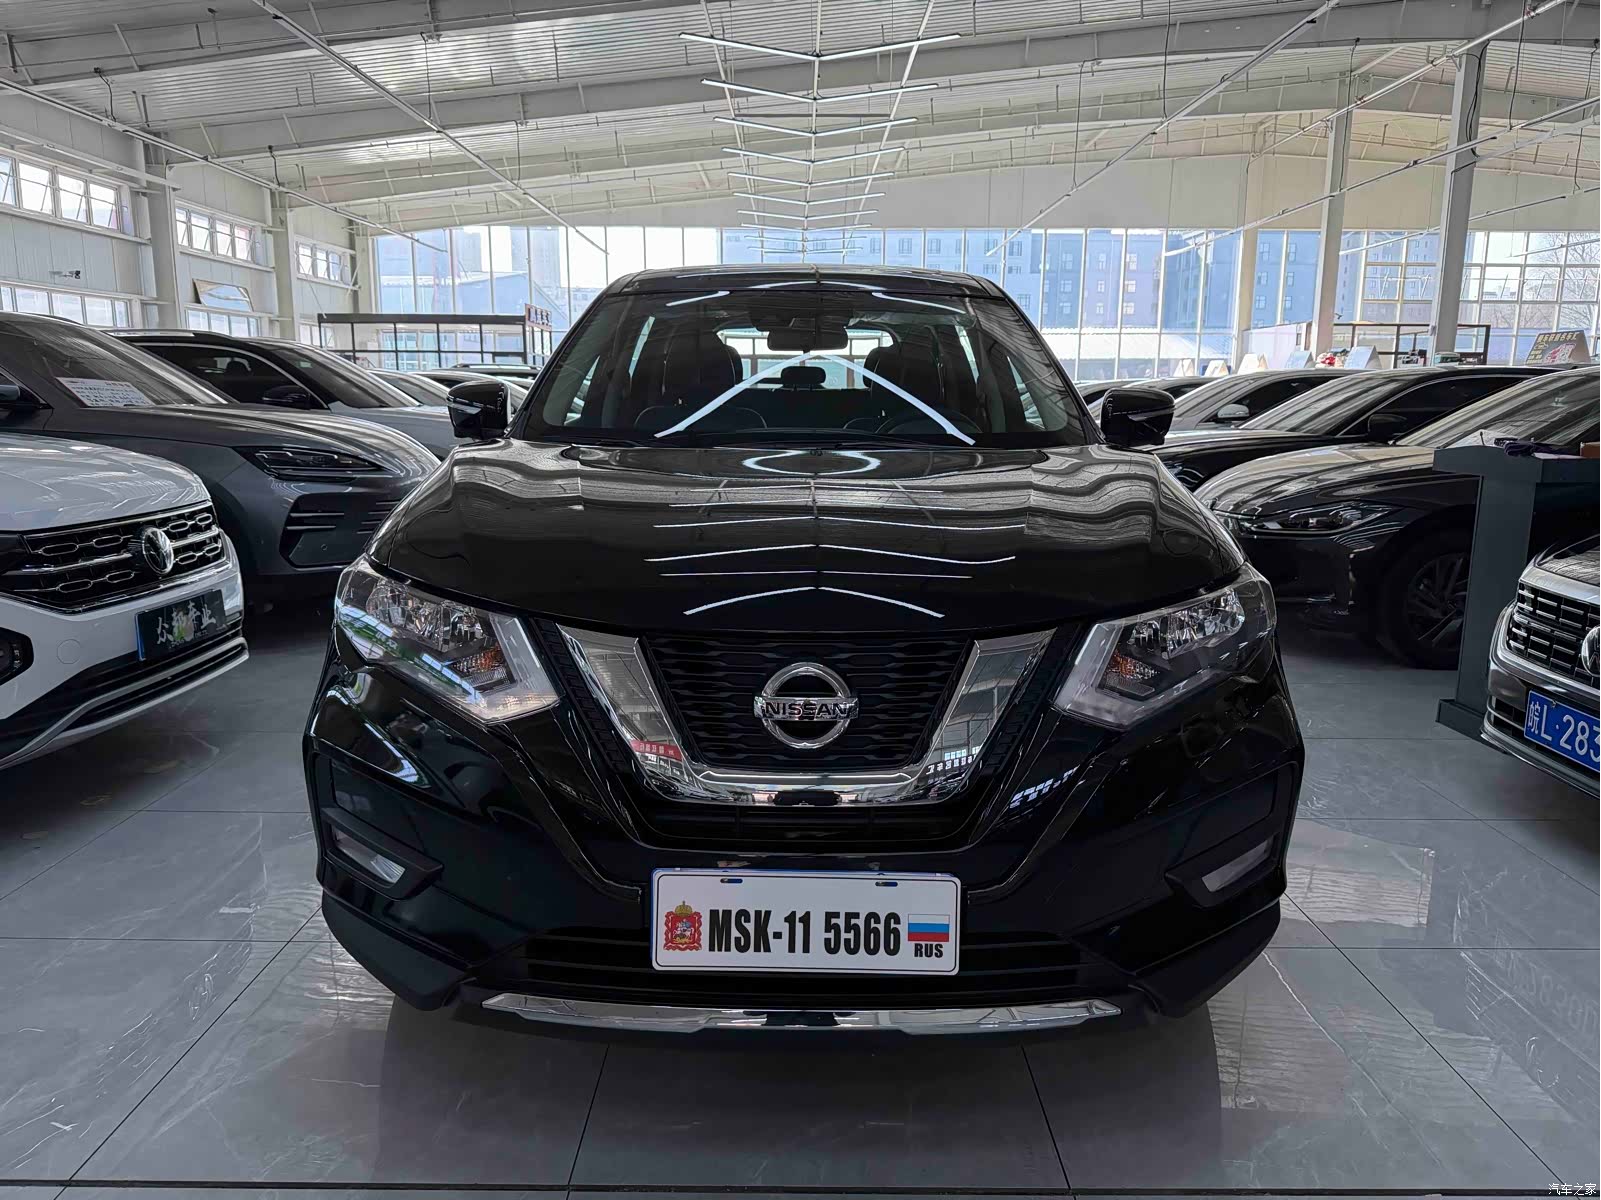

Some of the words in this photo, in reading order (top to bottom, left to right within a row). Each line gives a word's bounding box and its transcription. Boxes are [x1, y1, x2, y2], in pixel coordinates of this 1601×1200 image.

[765, 702, 849, 717] NISSAN
[708, 909, 811, 953] MSK-11
[824, 911, 901, 956] 5566
[914, 943, 943, 958] RUS
